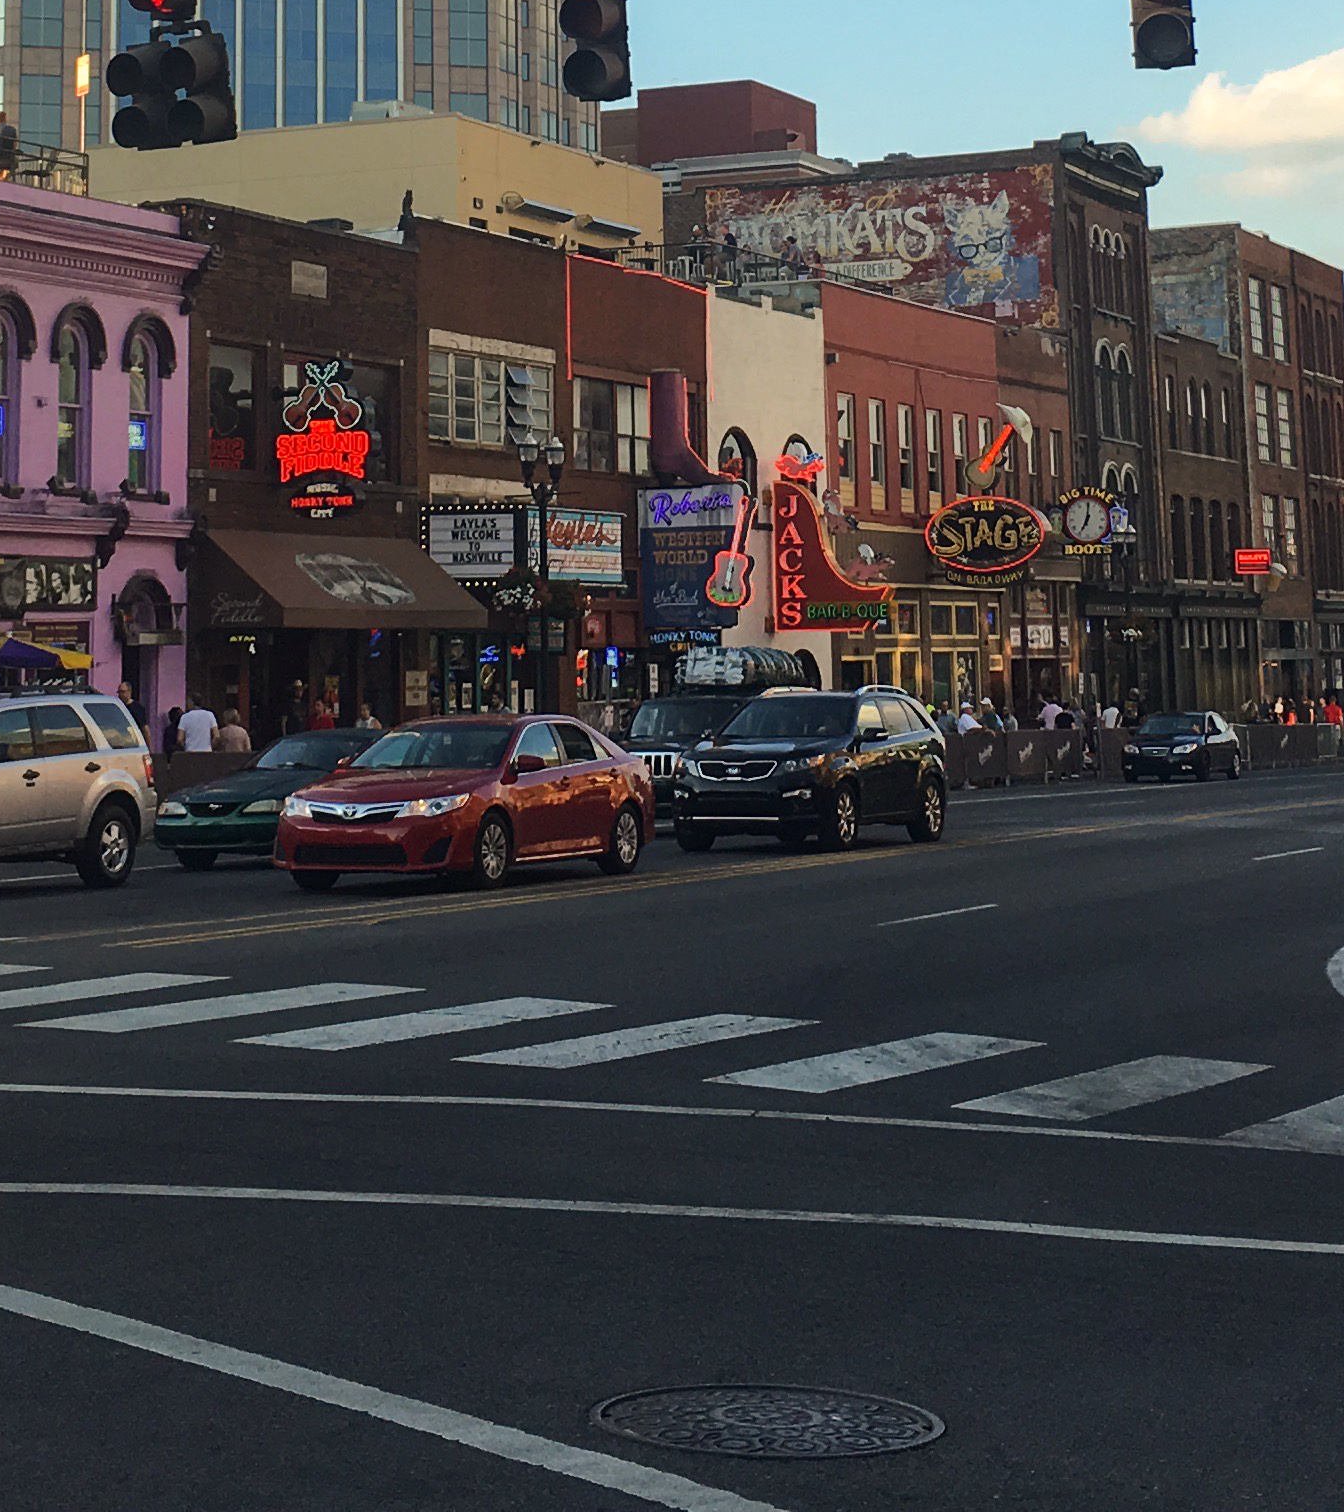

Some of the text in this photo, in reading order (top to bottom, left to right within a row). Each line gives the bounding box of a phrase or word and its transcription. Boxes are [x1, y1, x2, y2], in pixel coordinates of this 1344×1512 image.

[843, 262, 896, 279] DIFFERENCE
[309, 419, 336, 433] THE
[276, 431, 370, 459] SECOND
[280, 452, 366, 483] FIDDLE
[1058, 486, 1115, 506] BIG TIME
[972, 499, 996, 512] THE
[452, 517, 497, 529] LAYLA'S
[450, 529, 501, 541] WELCOME
[652, 530, 726, 547] WESTERN
[933, 509, 1041, 558] STAGE
[468, 541, 481, 552] TO
[1064, 544, 1113, 555] BOOTS
[452, 552, 504, 564] NASHVILLE
[652, 549, 708, 565] WORLD
[966, 570, 1025, 585] BROADWAY
[210, 592, 264, 608] Second
[210, 607, 265, 625] Fiddle
[650, 630, 719, 644] HONKY TONK
